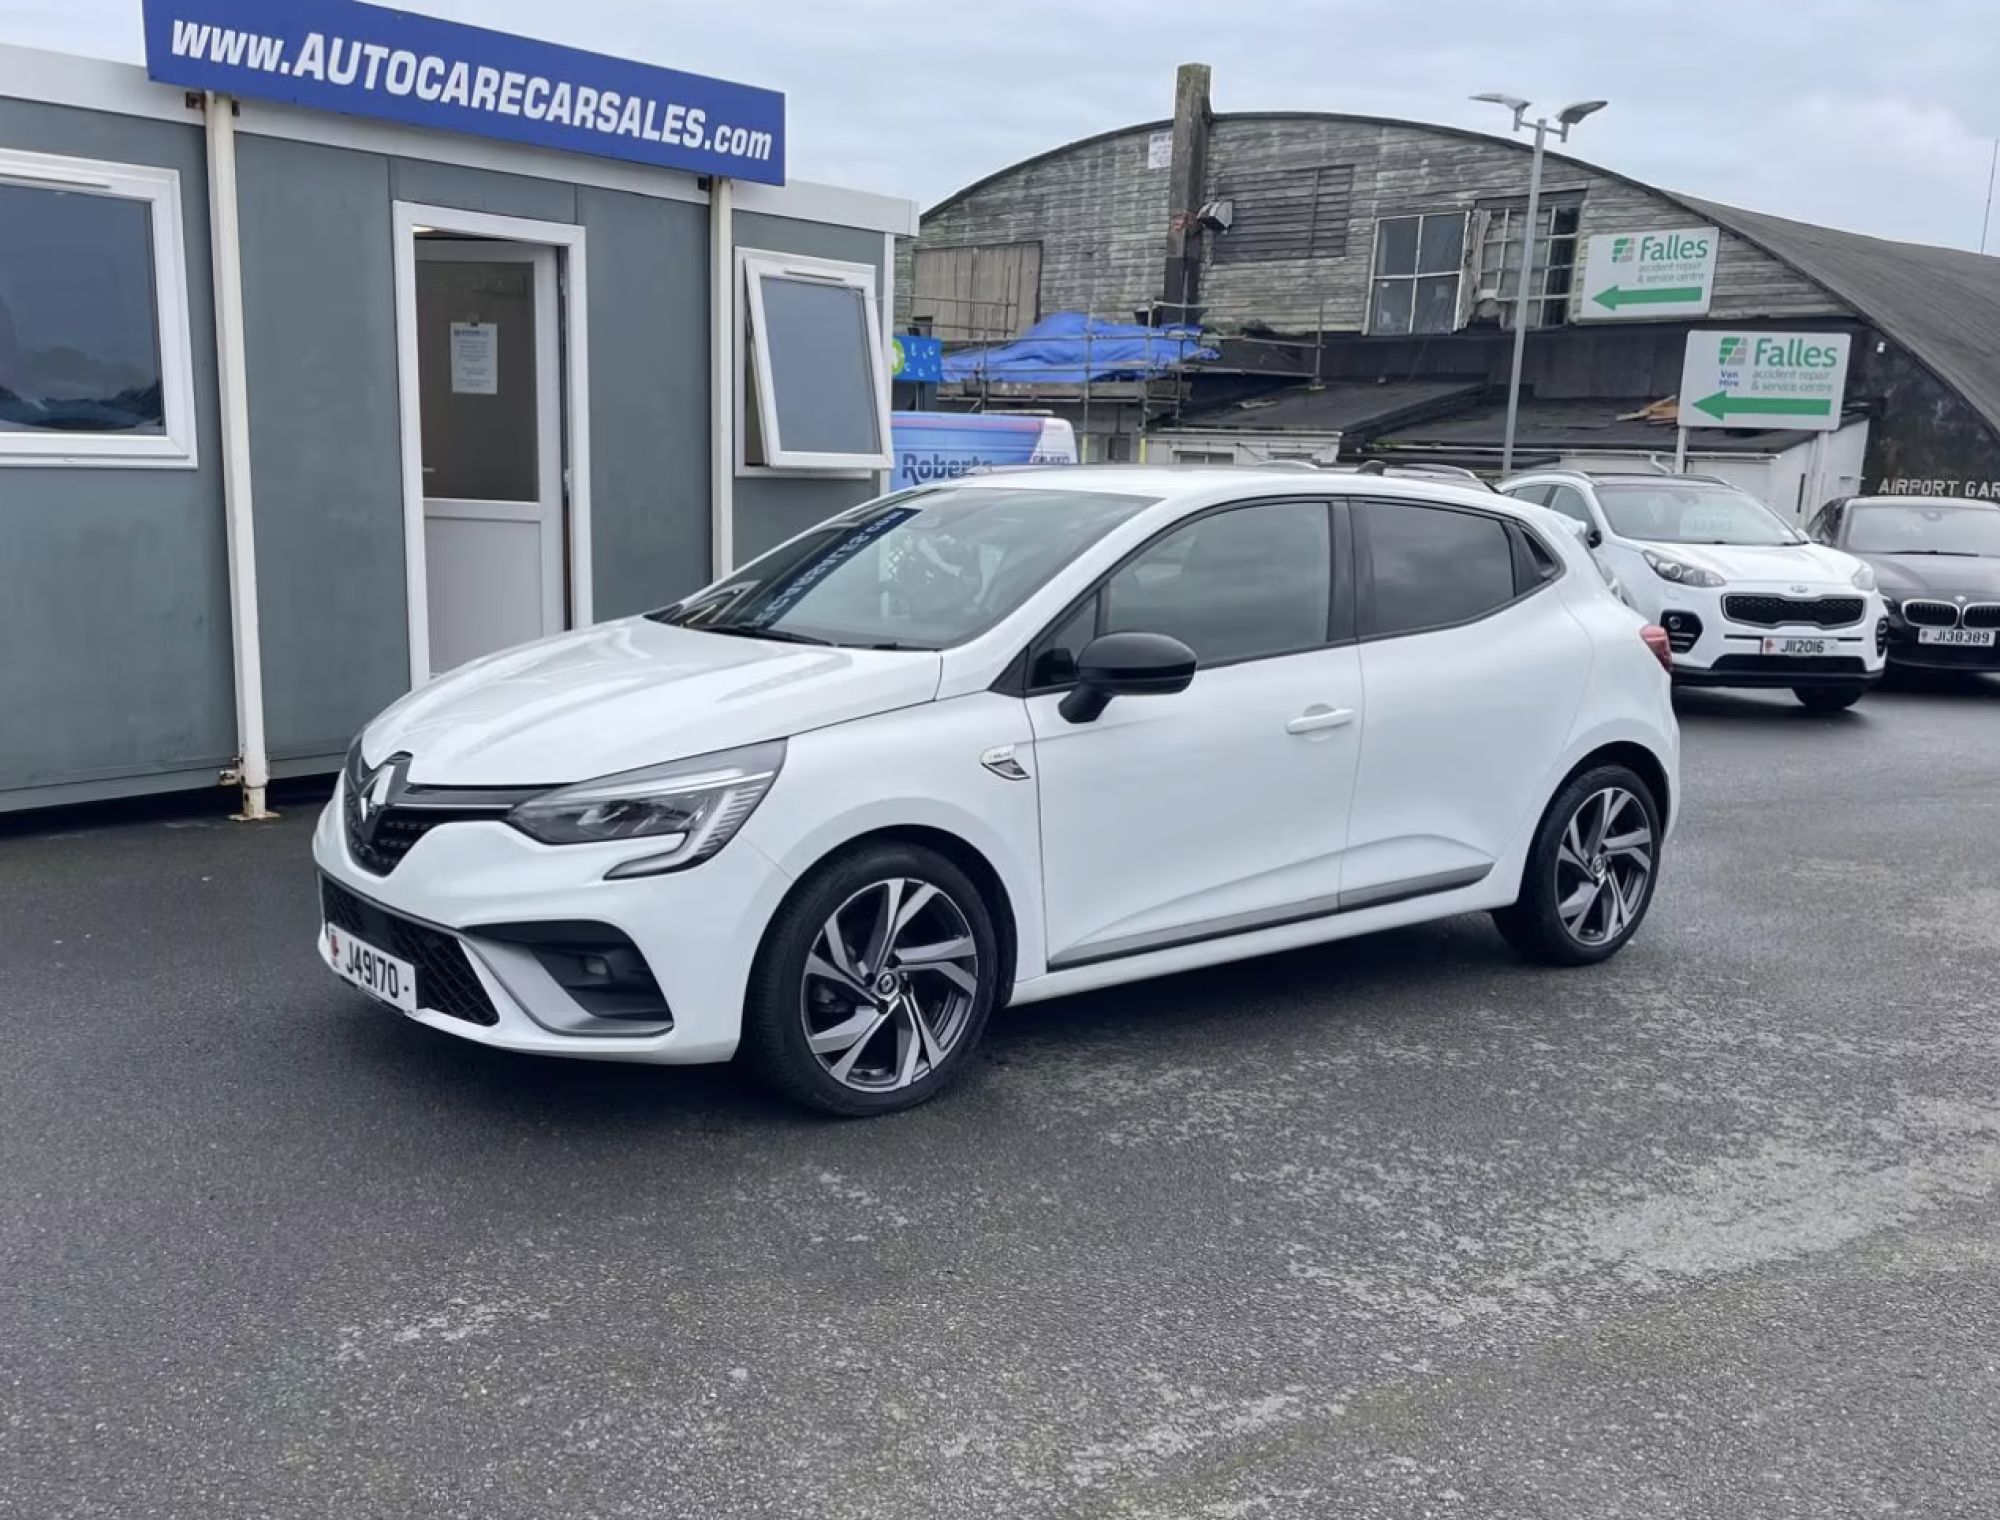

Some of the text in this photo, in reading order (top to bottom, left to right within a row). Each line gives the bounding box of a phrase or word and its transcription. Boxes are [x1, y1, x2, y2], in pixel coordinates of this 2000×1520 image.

[170, 19, 773, 161] www.AUTOCARECARSALES.com
[1640, 234, 1709, 262] Falles
[1754, 337, 1837, 368] Falles
[1719, 379, 1739, 387] Hire
[1720, 370, 1739, 379] Van
[1752, 368, 1831, 381] accident repair
[1751, 381, 1834, 392] & service centre
[902, 453, 993, 486] Rober
[1878, 478, 1960, 496] AIRPORT
[346, 940, 399, 999] J49170
